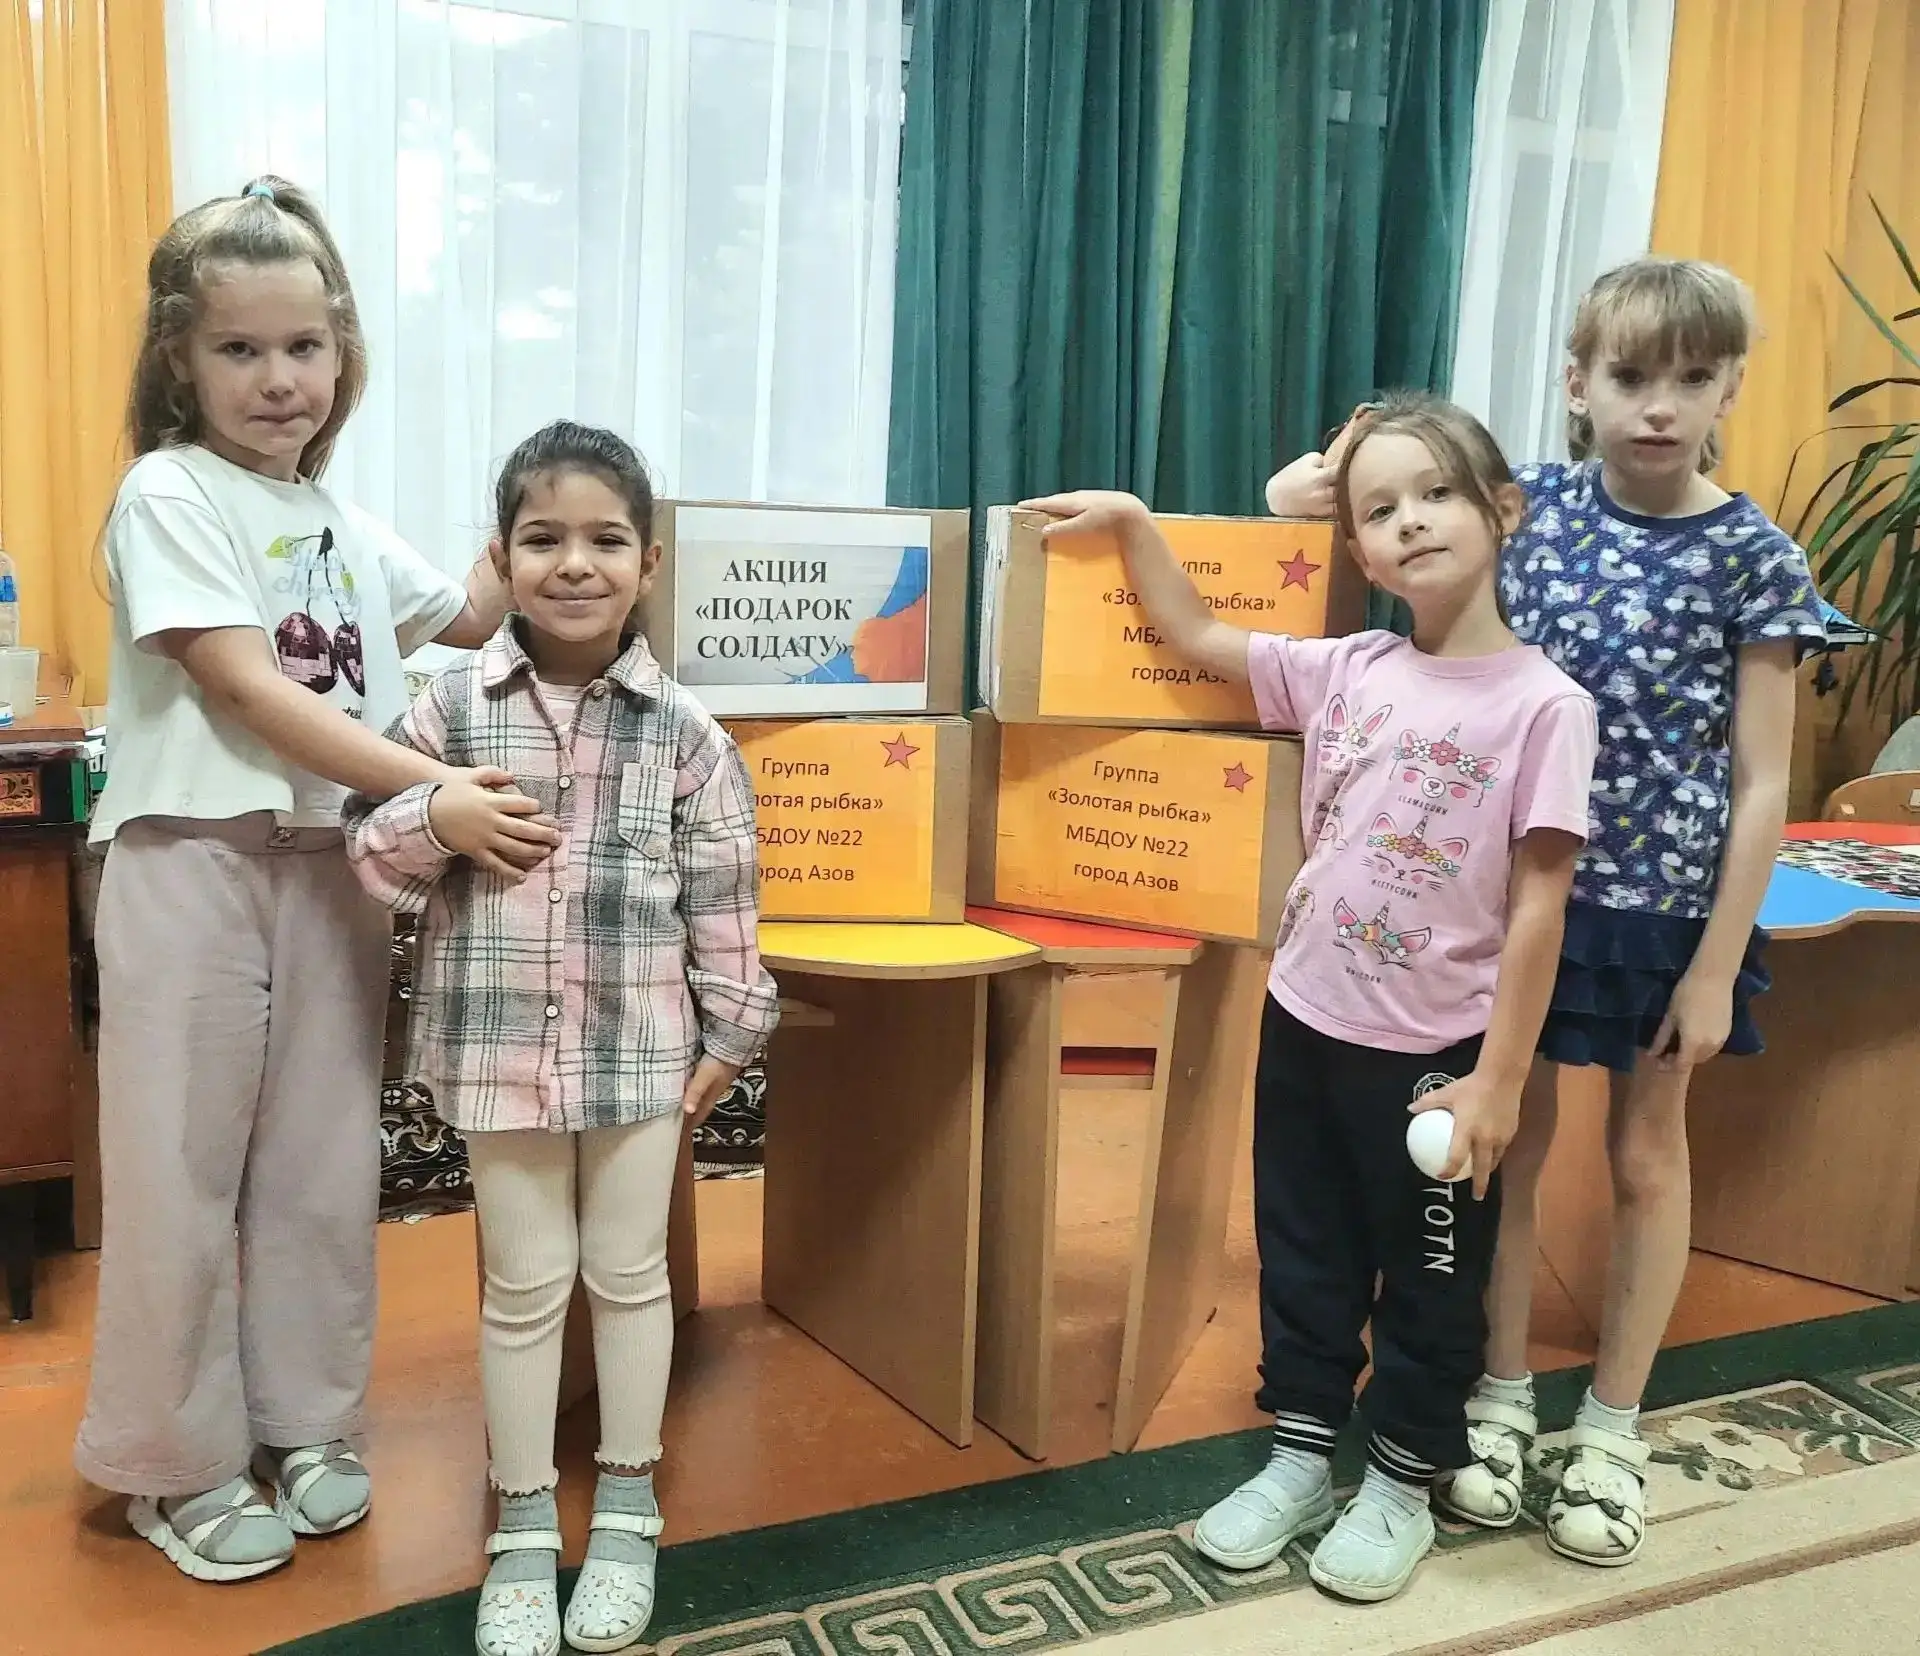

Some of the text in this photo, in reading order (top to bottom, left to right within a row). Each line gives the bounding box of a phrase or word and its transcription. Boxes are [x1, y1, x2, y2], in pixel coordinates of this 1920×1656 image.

[722, 559, 828, 587] АКЦИЯ
[695, 597, 853, 625] «ПОДАРОК
[697, 635, 849, 662] СОЛДАТУ»
[1131, 667, 1191, 686] город
[761, 757, 830, 778] Группа
[1093, 760, 1160, 784] Группа
[810, 793, 884, 812] рыбка»
[1048, 787, 1211, 824] «Золотая рыбка»
[756, 828, 863, 847] БДОУ №22
[1065, 824, 1189, 858] МБДОУ №22
[807, 864, 855, 881] Азов
[1073, 862, 1179, 892] город Азов
